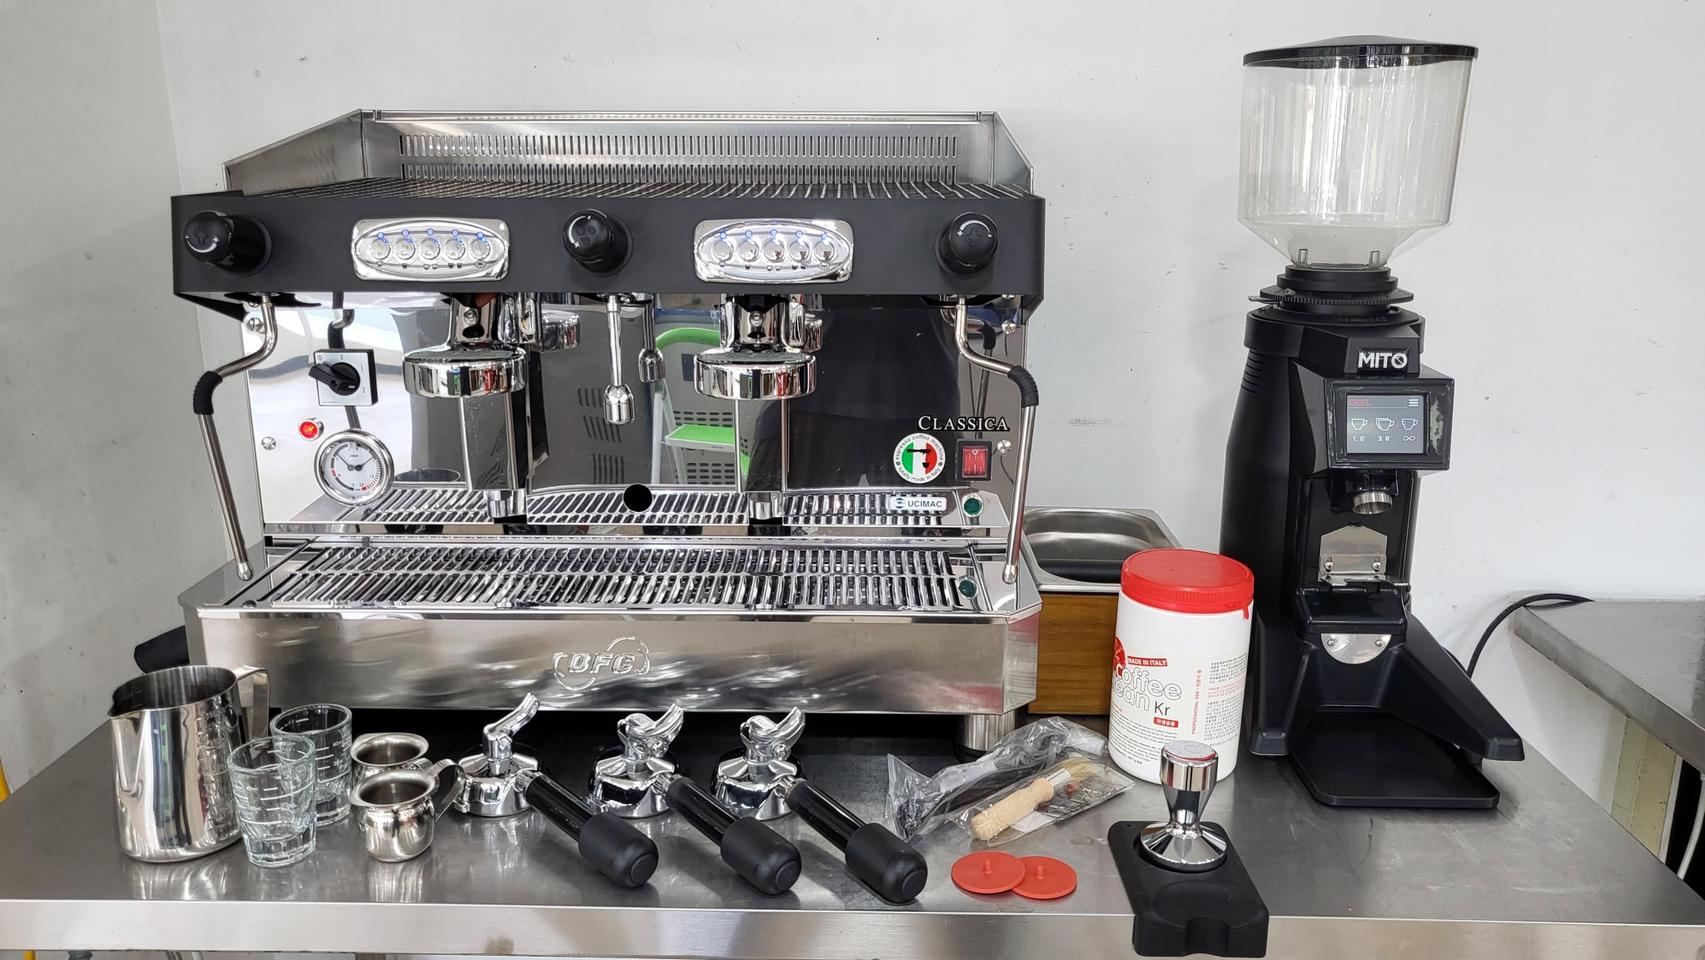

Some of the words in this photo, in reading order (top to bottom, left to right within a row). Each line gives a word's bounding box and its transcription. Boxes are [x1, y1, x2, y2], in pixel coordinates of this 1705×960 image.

[1357, 352, 1408, 369] MITO
[907, 500, 942, 508] UCIMAC
[1129, 657, 1142, 665] MADE
[1154, 701, 1171, 716] Kr
